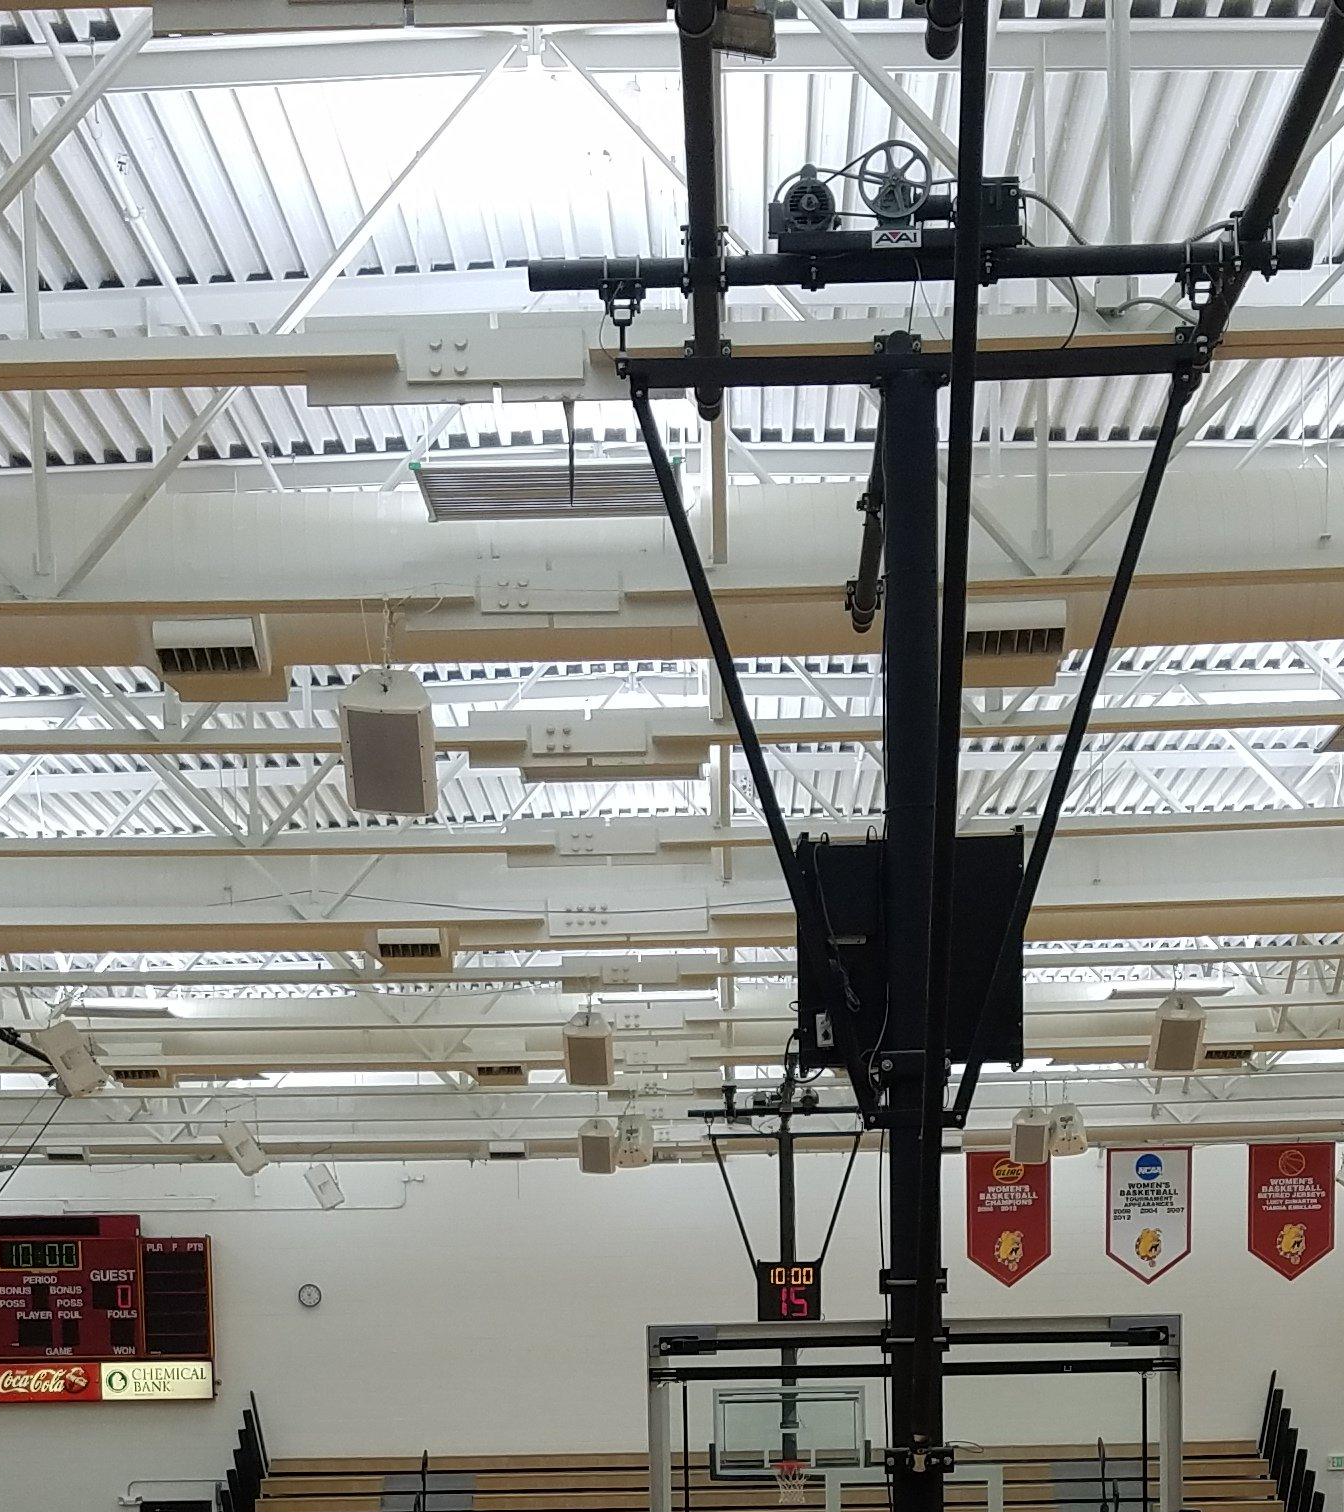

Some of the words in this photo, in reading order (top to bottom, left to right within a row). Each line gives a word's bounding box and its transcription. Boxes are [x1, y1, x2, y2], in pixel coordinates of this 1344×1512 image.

[1128, 1181, 1171, 1190] WOMEN'S
[1270, 1177, 1314, 1186] WOMEN'S
[987, 1185, 1030, 1193] WOMEN'S
[1119, 1189, 1179, 1197] BASKETBALL
[1261, 1185, 1323, 1193] BASKETBALL
[979, 1192, 1038, 1200] BASKETBALL
[146, 1243, 163, 1252] PLR
[186, 1243, 204, 1251] PTS
[23, 1275, 58, 1285] PERIOD
[90, 1269, 136, 1282] GUEST
[770, 1267, 813, 1285] 10:00
[49, 1286, 83, 1294] BONUS
[0, 1299, 26, 1308] POSS
[56, 1299, 83, 1307] POSS
[781, 1287, 808, 1316] 15
[16, 1311, 53, 1320] PLAYER
[58, 1310, 83, 1319] FOUL
[107, 1310, 138, 1319] FOULS
[45, 1347, 73, 1356] GAME
[112, 1346, 136, 1355] WON
[131, 1367, 208, 1381] CHEMICAL
[133, 1381, 171, 1393] BANK
